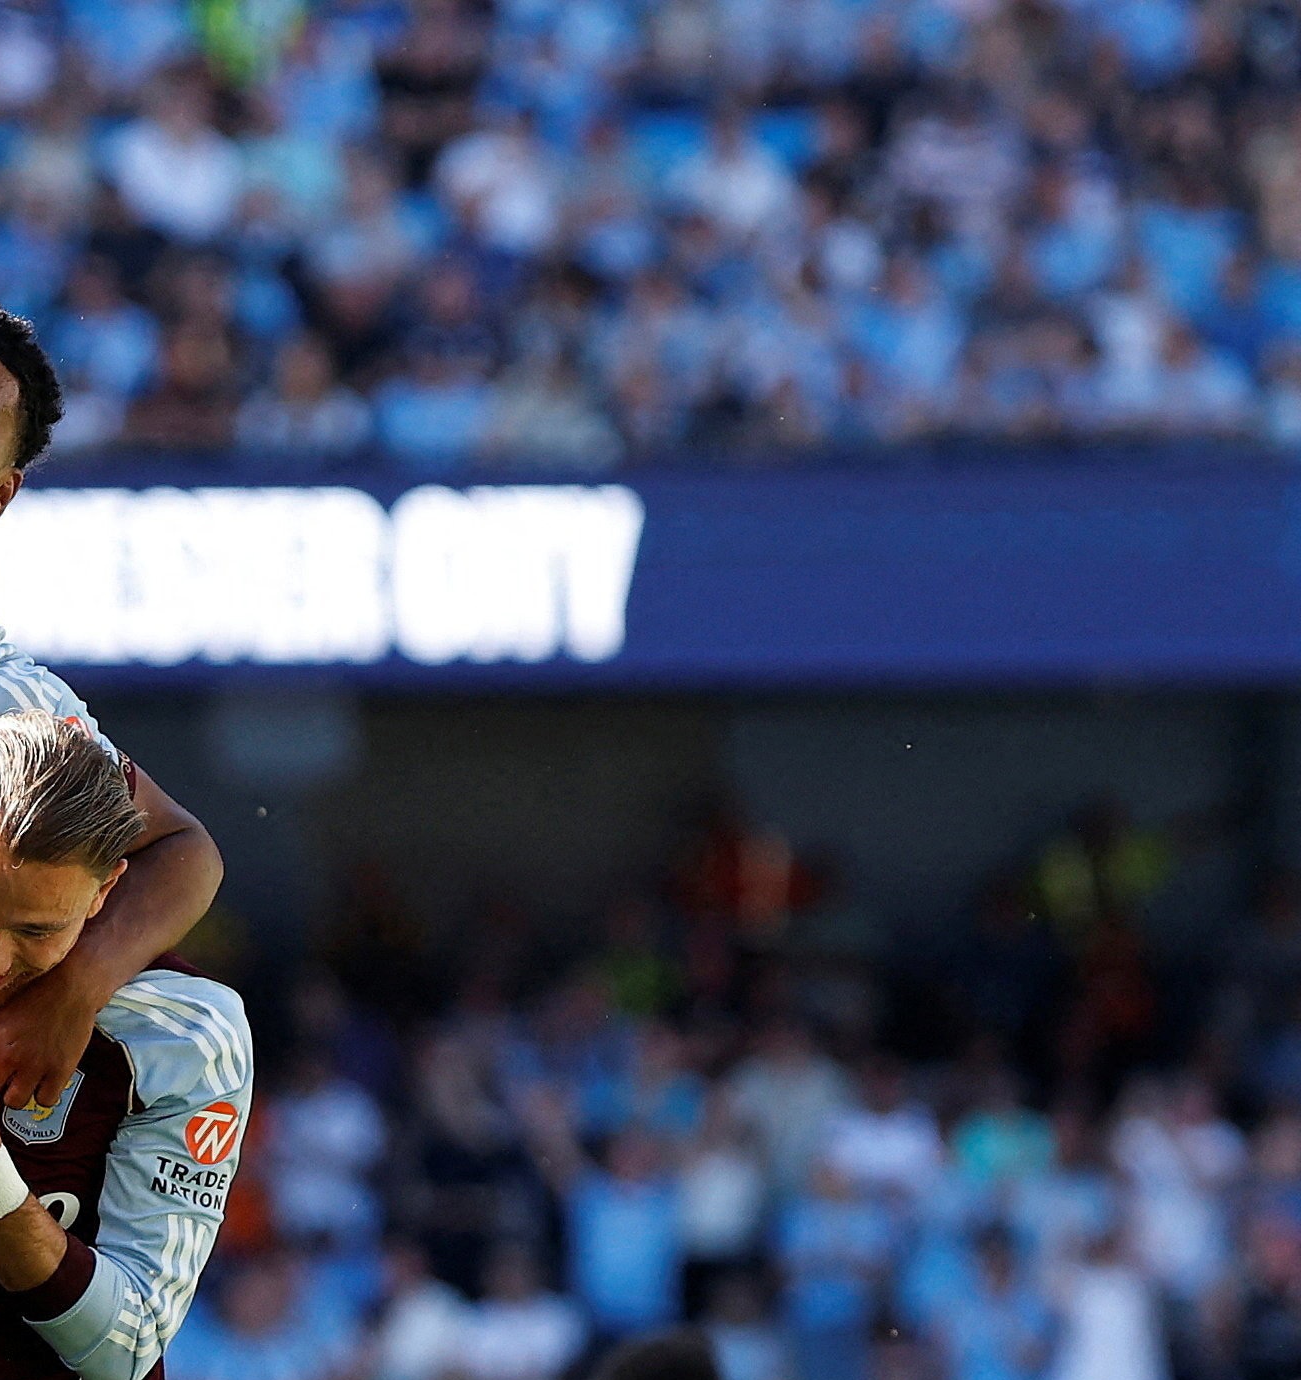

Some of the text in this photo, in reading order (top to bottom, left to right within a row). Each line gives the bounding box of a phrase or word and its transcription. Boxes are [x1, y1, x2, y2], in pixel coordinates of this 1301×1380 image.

[7, 1117, 56, 1138] ASTON VILLA
[156, 1155, 228, 1190] TRADE
[150, 1176, 223, 1210] NATION
